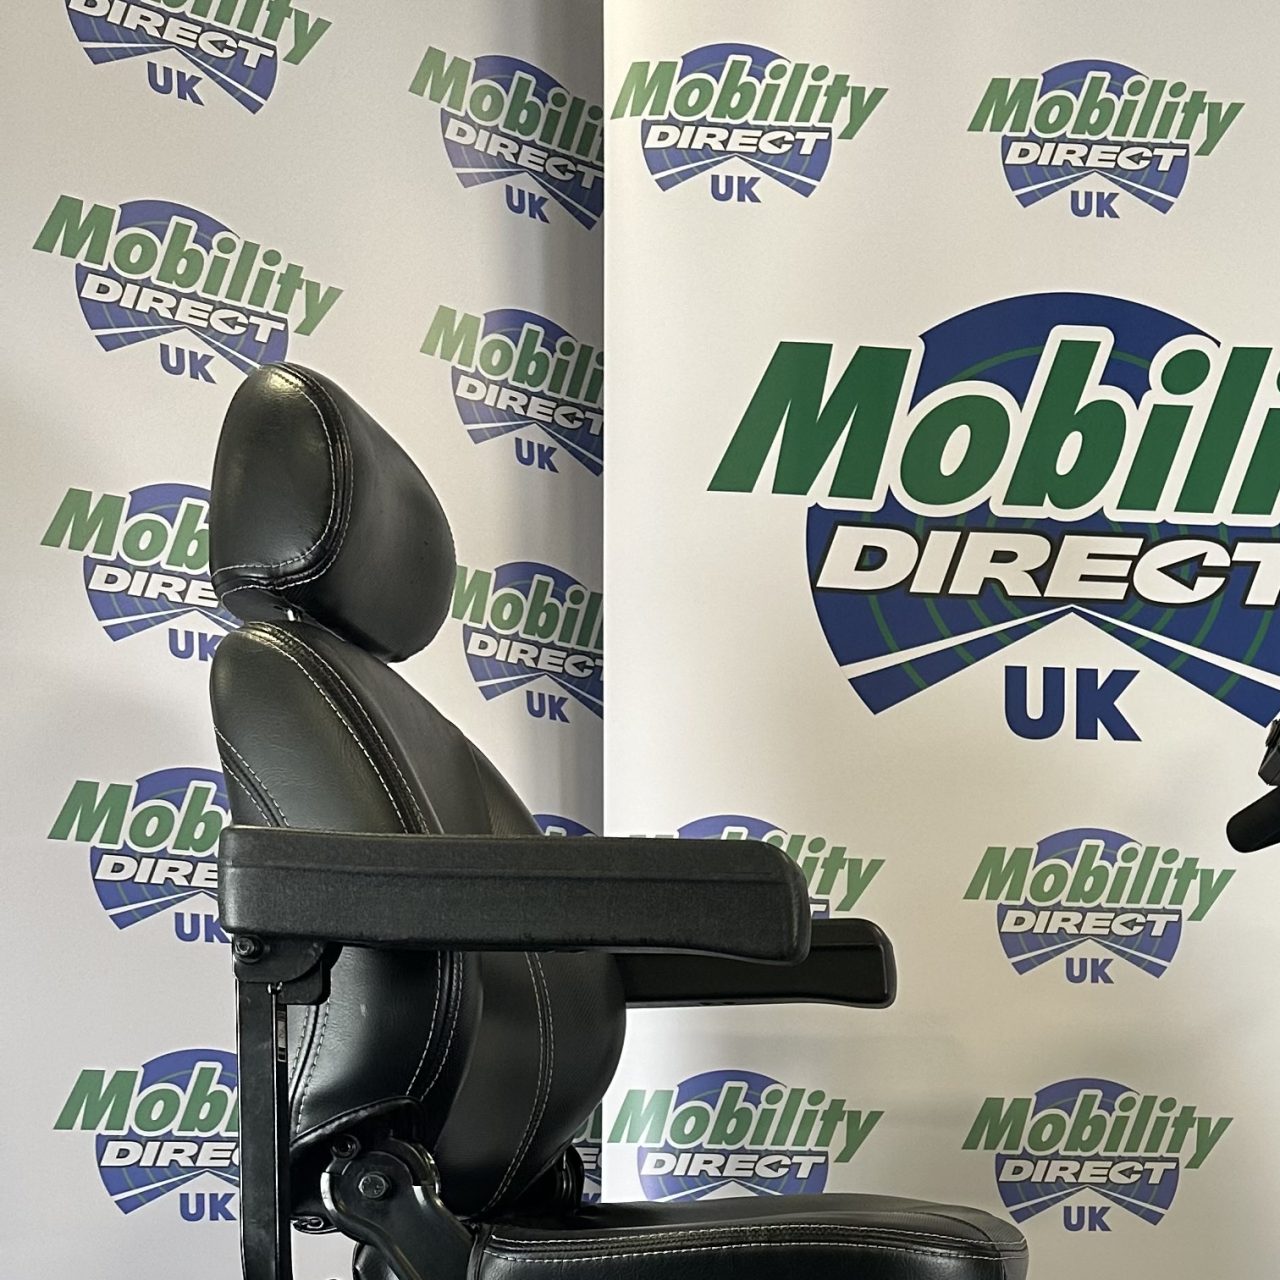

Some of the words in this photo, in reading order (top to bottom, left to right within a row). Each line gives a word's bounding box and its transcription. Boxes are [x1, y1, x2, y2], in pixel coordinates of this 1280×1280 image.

[68, 0, 274, 68] DIRECT
[147, 61, 205, 107] UK
[610, 59, 889, 140] Mobility
[408, 46, 604, 165] Mobili
[967, 76, 1245, 156] Mobility
[444, 117, 604, 190] DIRECT
[644, 124, 830, 155] DIRECT
[1004, 141, 1187, 171] DIRECT
[505, 184, 550, 224] UK
[710, 174, 761, 203] UK
[1070, 190, 1120, 219] UK
[32, 194, 344, 336] Mobility
[80, 274, 285, 343] DIRECT
[160, 343, 216, 384] UK
[420, 304, 604, 405] Mobili
[456, 374, 604, 435] DIRECT
[515, 437, 559, 474] UK
[88, 565, 219, 608] DIRE
[451, 565, 603, 652] Mobil
[168, 628, 216, 661] UK
[467, 632, 603, 680] DIREC
[526, 690, 570, 723] UK
[1004, 665, 1142, 742] UK
[94, 854, 218, 887] DIRE
[962, 844, 1237, 921] Mobility
[175, 913, 231, 944] UK
[1000, 910, 1180, 937] DIRECT
[1065, 958, 1115, 985] UK
[607, 1086, 885, 1163] Mobility
[961, 1094, 1234, 1169] Mobility
[640, 1152, 826, 1179] DIRECT
[998, 1160, 1177, 1184] DIRECT
[179, 1192, 236, 1222] UK
[1063, 1206, 1112, 1232] UK
